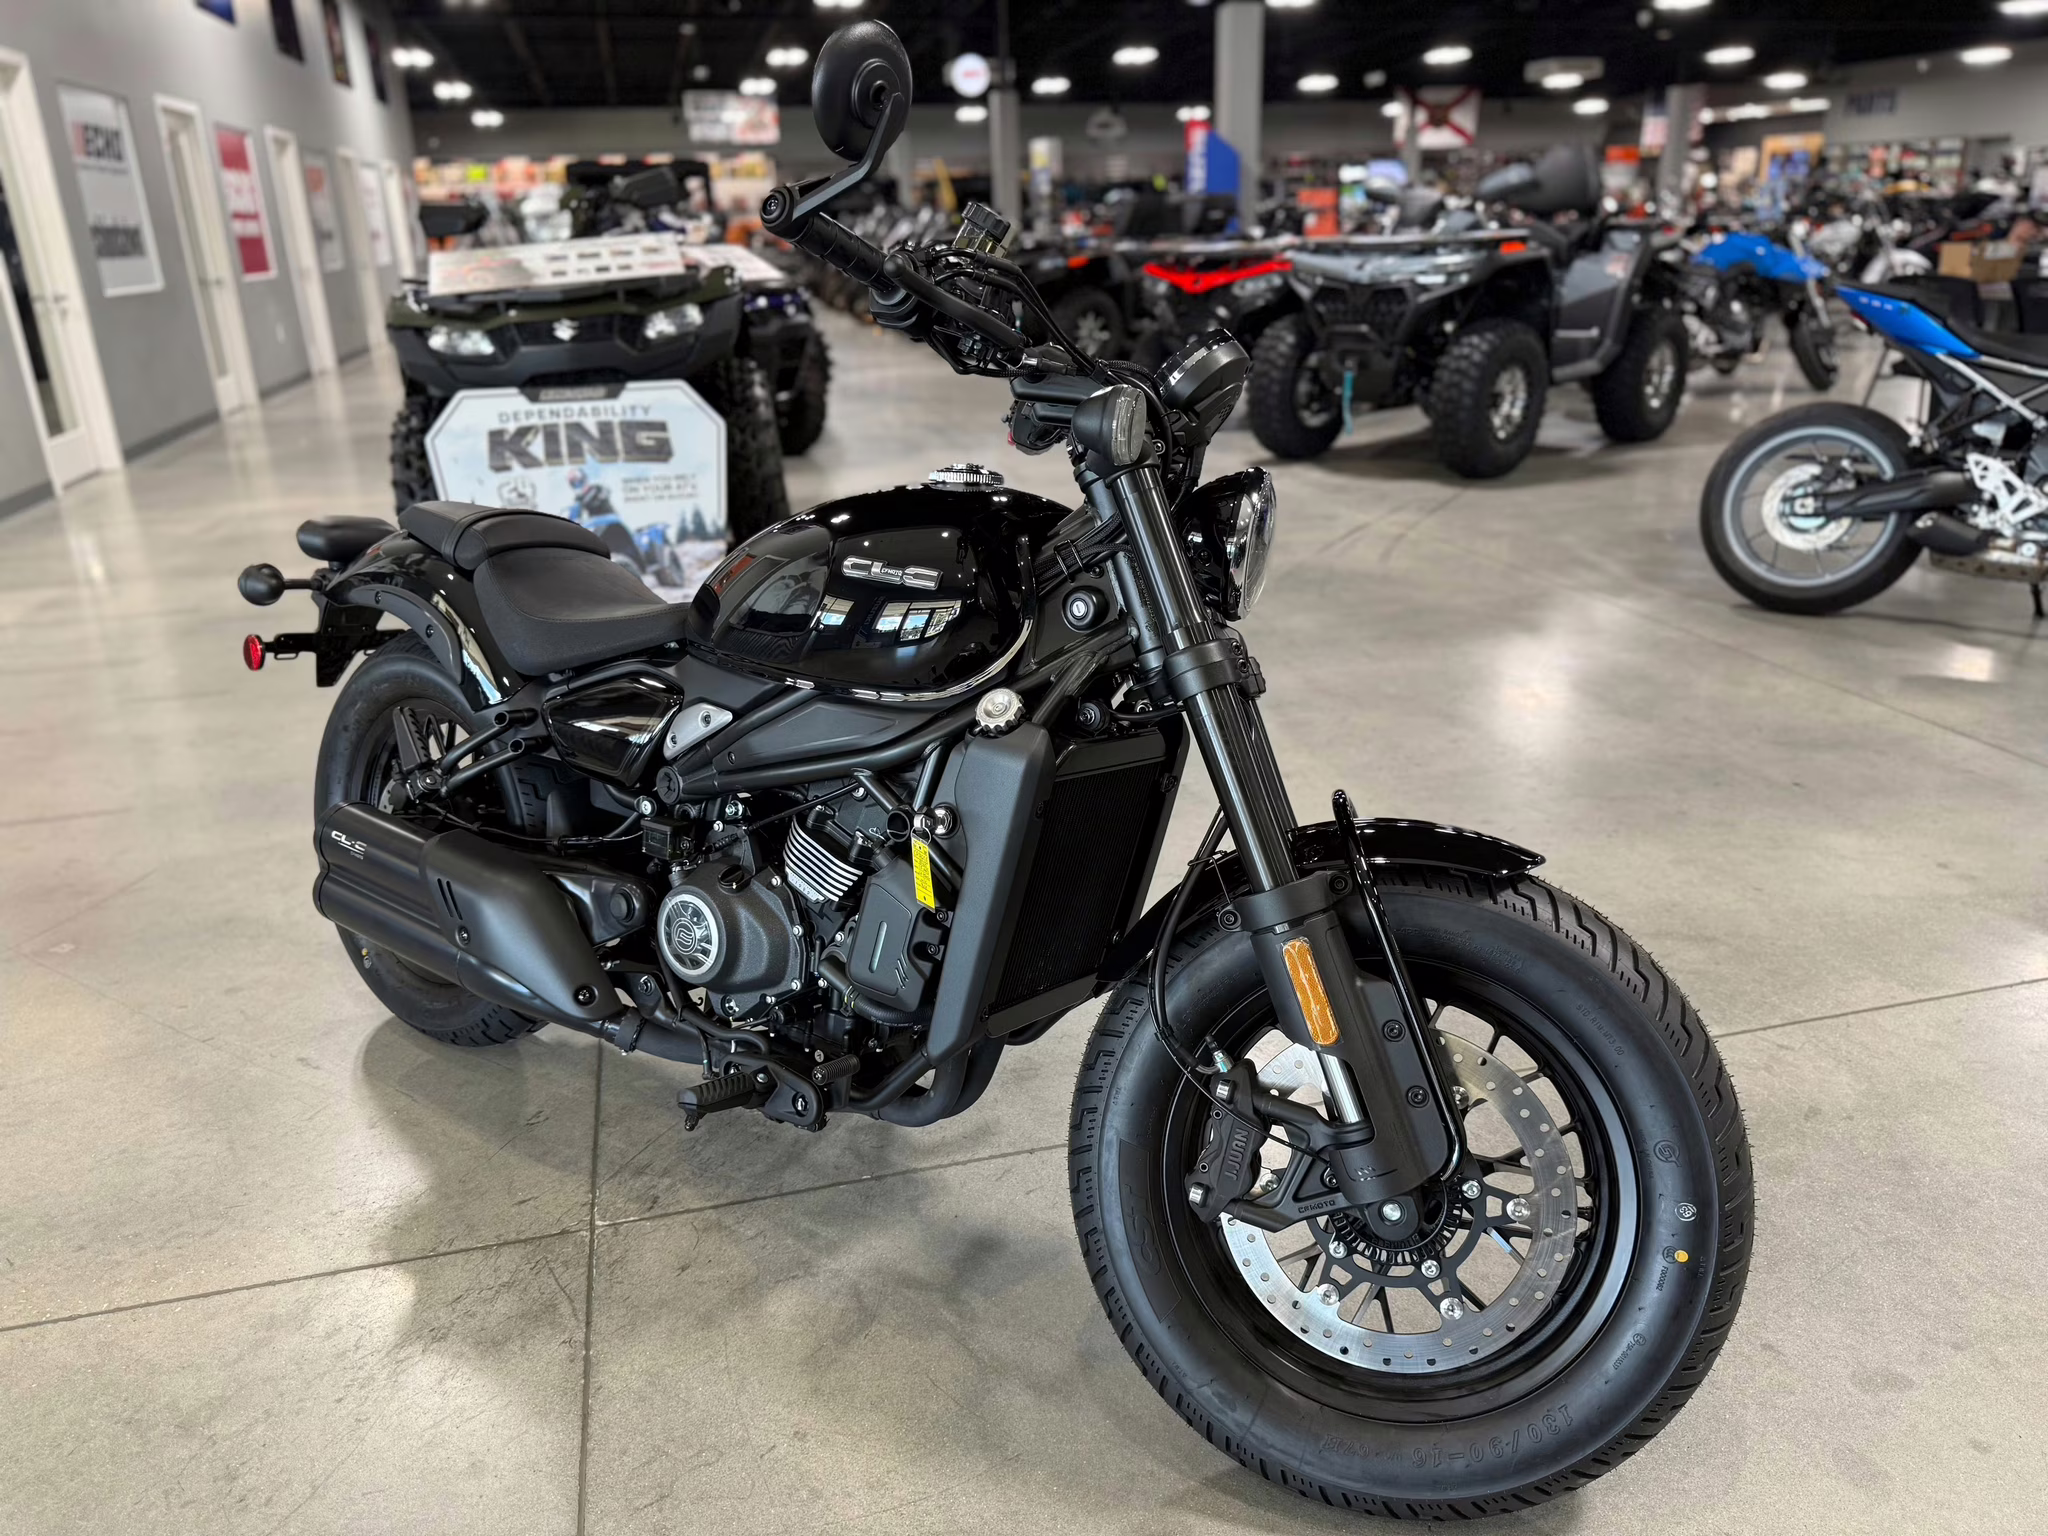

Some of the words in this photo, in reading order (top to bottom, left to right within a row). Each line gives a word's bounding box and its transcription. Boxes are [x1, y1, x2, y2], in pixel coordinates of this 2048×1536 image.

[497, 404, 652, 424] DEPENDABILITY
[488, 420, 674, 473] KING
[1223, 1127, 1250, 1181] J.JUAN
[1298, 1200, 1336, 1214] CFMOTO
